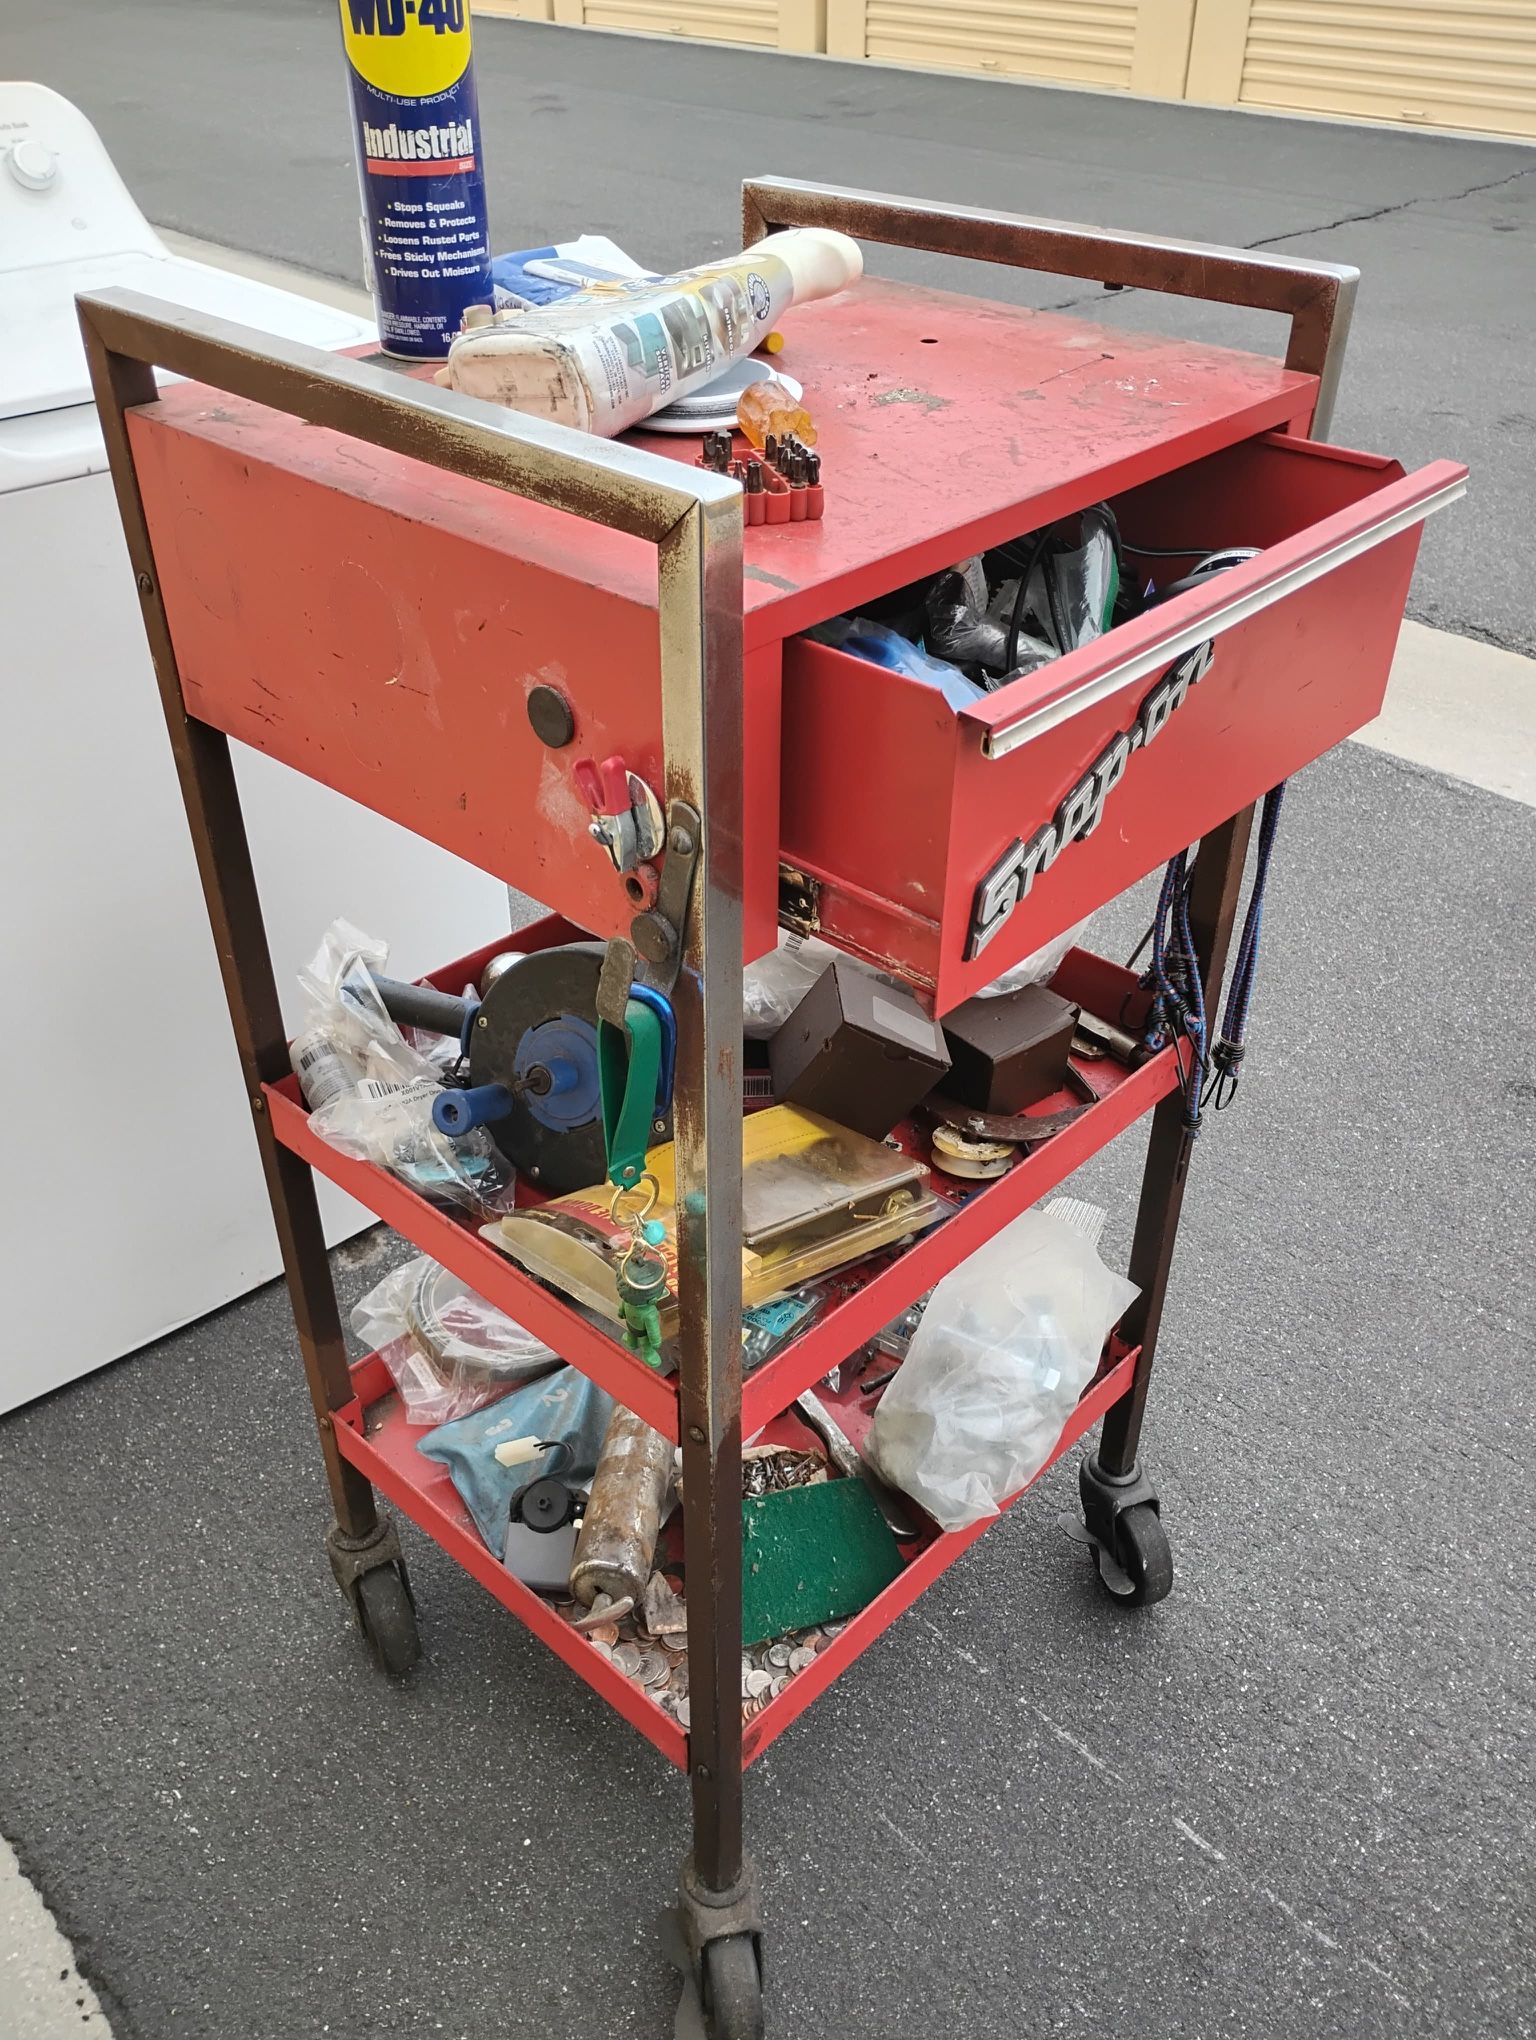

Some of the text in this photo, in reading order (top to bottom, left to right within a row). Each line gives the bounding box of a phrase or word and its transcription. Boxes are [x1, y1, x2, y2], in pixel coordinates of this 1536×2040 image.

[366, 83, 460, 106] MULTI-USE PRODUCT
[362, 119, 474, 159] Industrial
[394, 200, 465, 214] Stops Squeaks
[384, 216, 476, 229] Removes & Protects
[384, 231, 480, 245] Loosens Rusted Parts
[380, 246, 485, 264] Frees Sticky Mechanisms
[390, 265, 480, 278] Drives Out Moisture
[413, 1093, 428, 1102] Dryer
